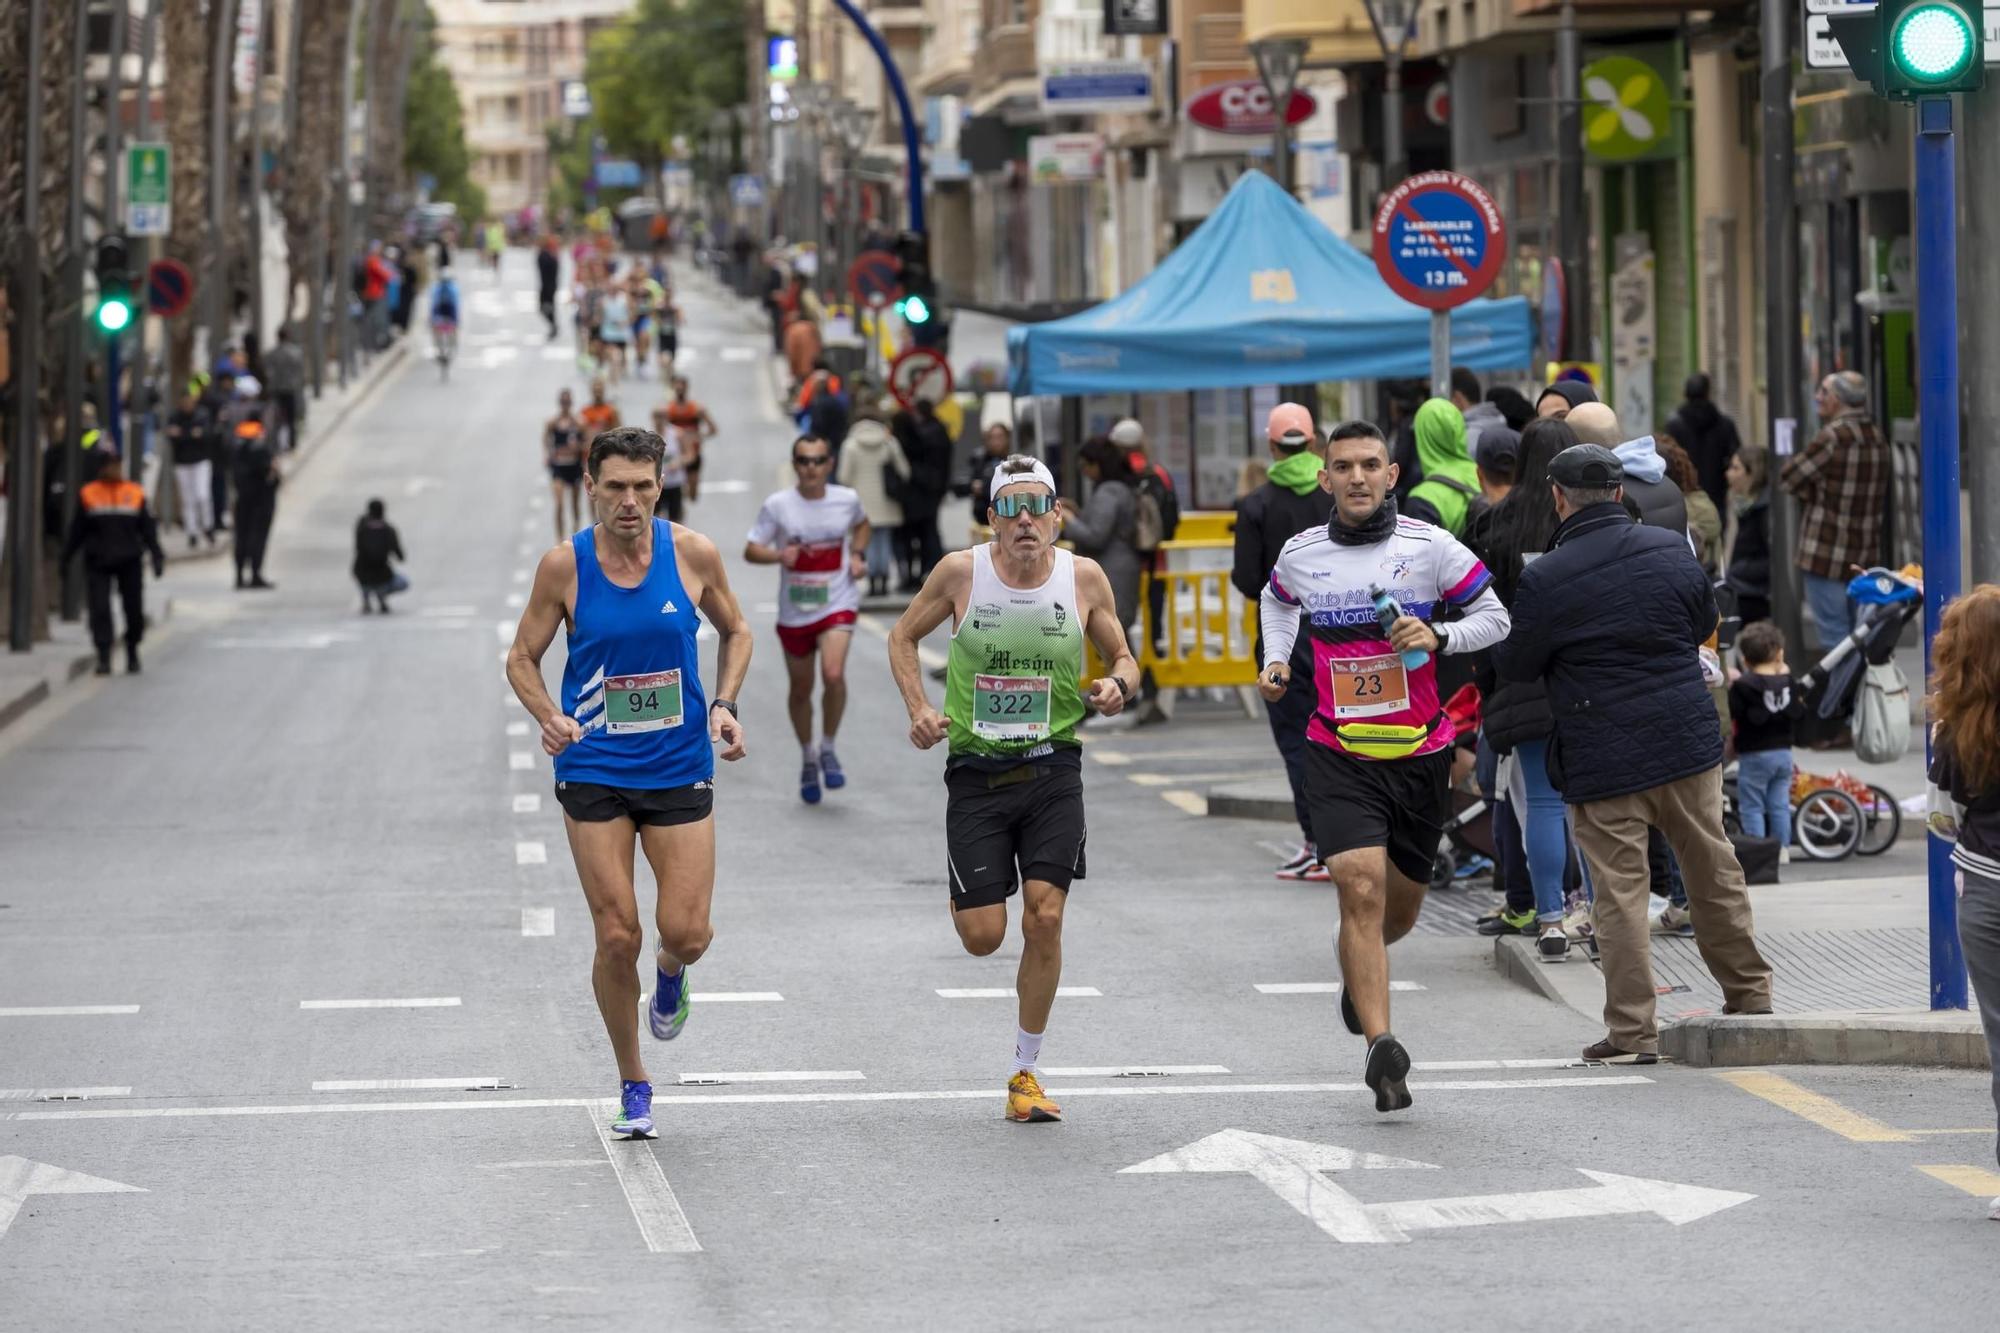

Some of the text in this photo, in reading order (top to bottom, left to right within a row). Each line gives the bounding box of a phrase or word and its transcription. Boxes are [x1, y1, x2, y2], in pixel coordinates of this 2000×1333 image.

[1376, 173, 1500, 234] EXCEPTO CARGA Y DESCARGA
[1403, 220, 1473, 231] LABORABLES
[1402, 234, 1417, 244] de
[1400, 247, 1415, 257] de
[1425, 270, 1468, 286] 13 m.
[1308, 591, 1340, 608] Club
[985, 650, 1054, 671] Mesón
[1354, 674, 1382, 696] 23
[628, 690, 660, 713] 94
[988, 694, 1032, 715] 322
